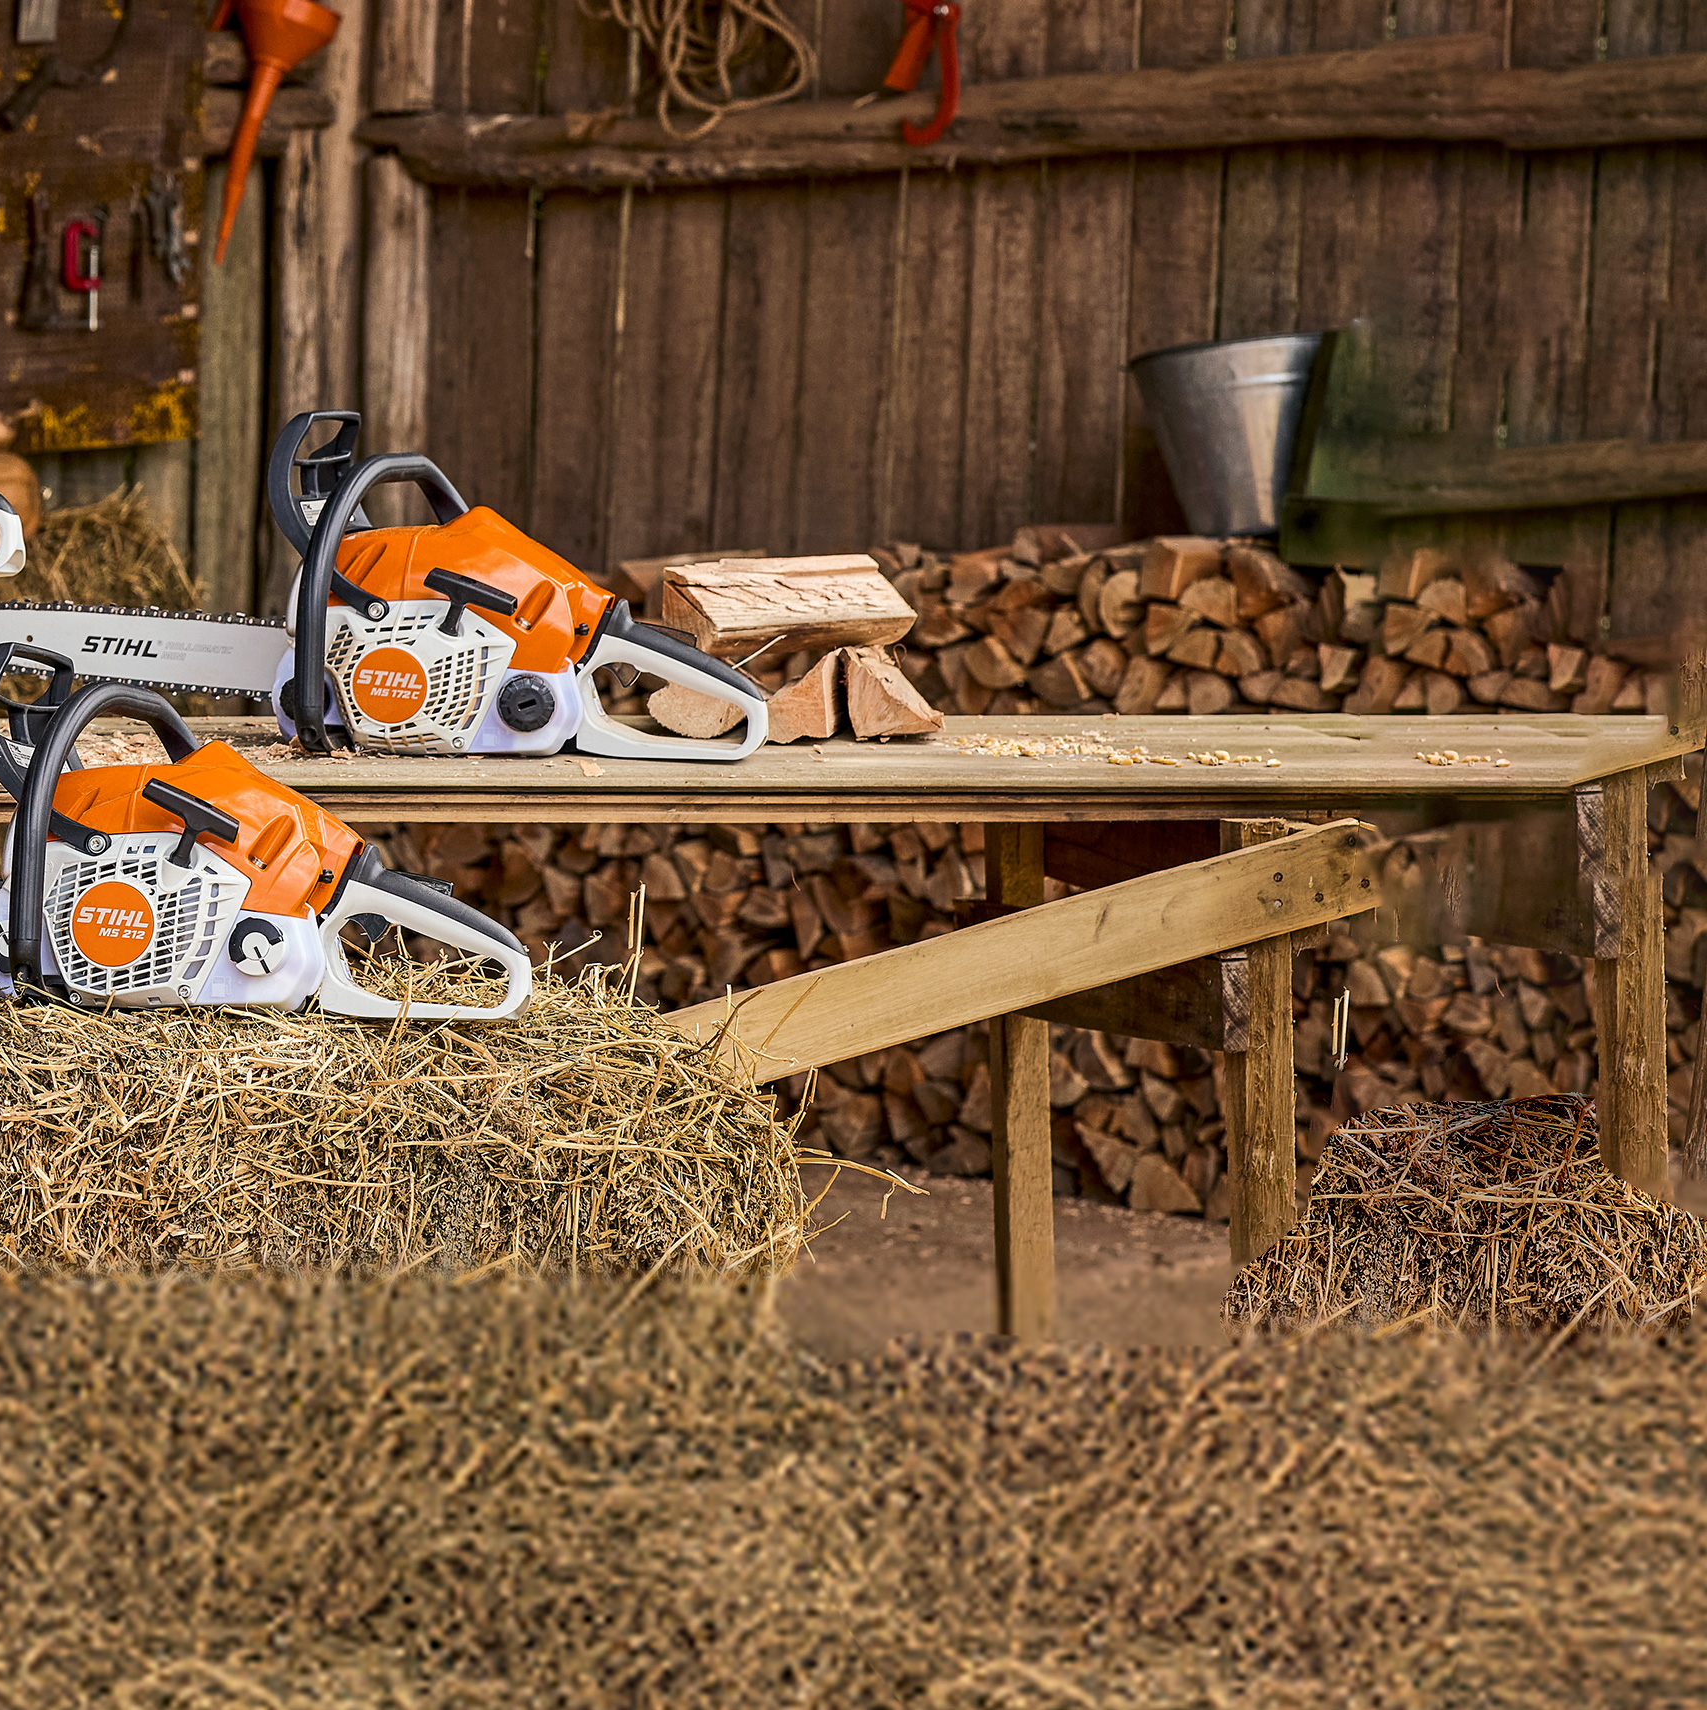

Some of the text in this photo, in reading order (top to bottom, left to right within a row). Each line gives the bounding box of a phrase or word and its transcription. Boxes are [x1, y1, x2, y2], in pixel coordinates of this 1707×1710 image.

[81, 635, 158, 658] STIHL
[356, 668, 423, 690] STIHL
[370, 687, 390, 697] MS
[76, 906, 149, 928] STIHL
[98, 927, 146, 940] MS 212
